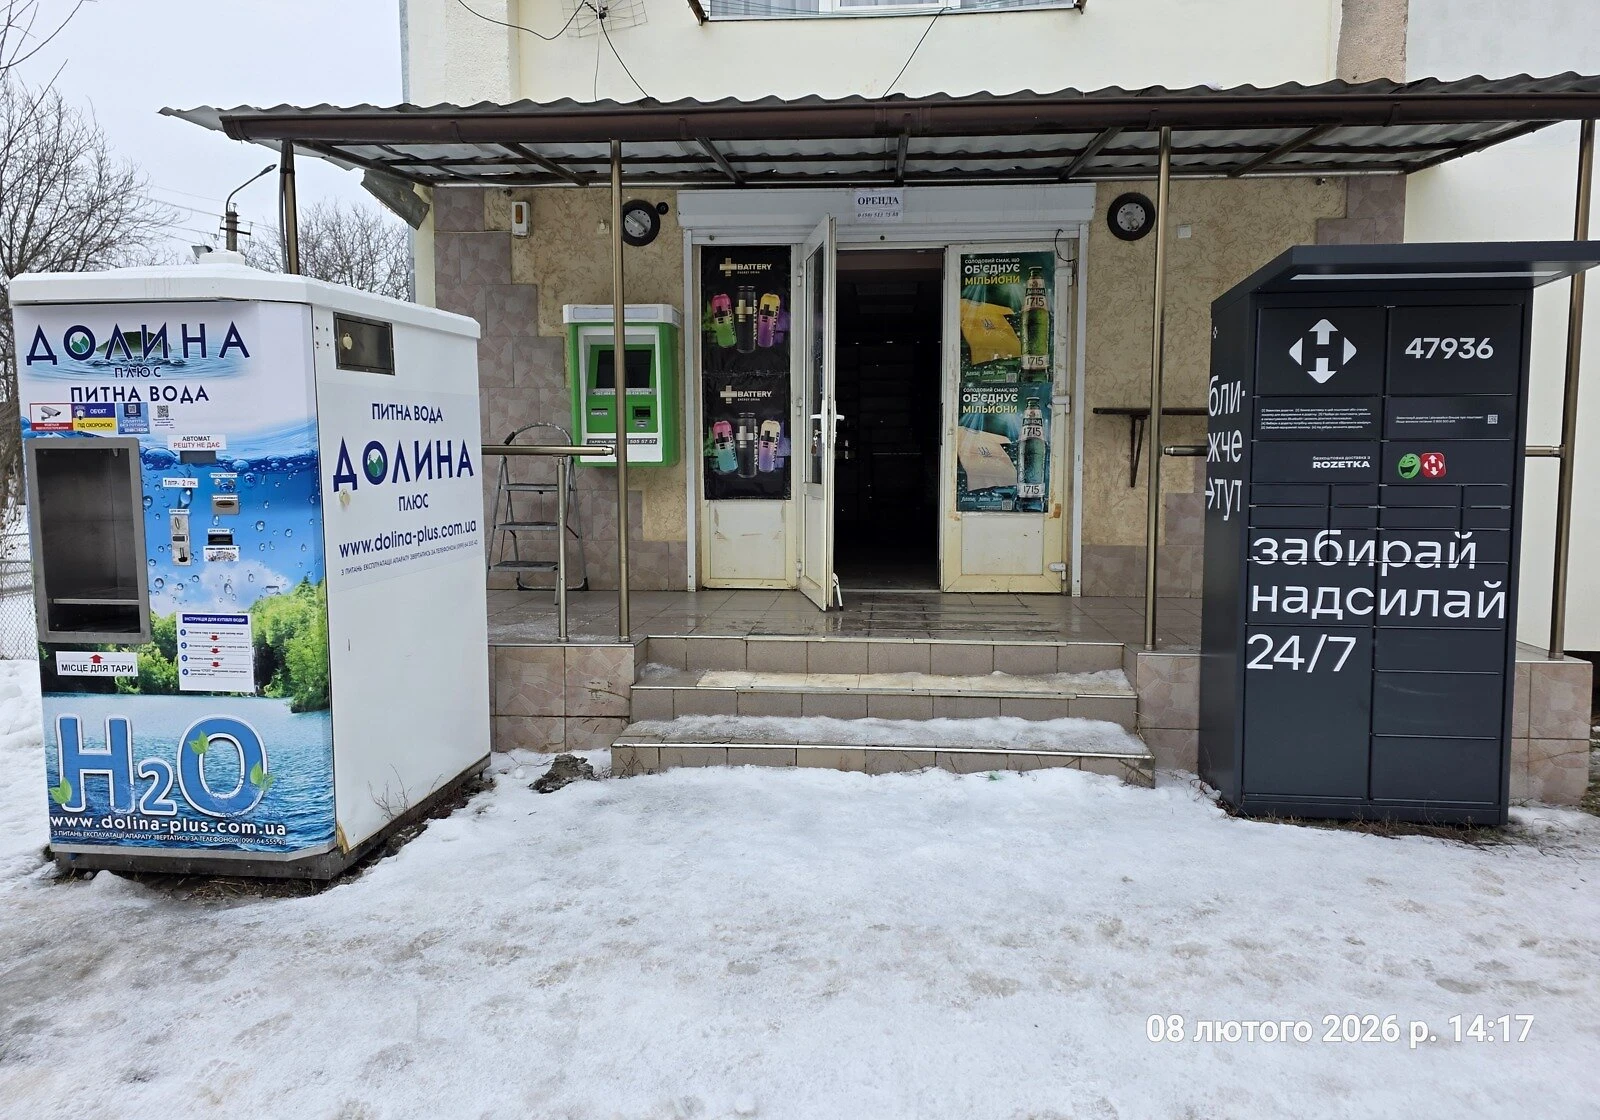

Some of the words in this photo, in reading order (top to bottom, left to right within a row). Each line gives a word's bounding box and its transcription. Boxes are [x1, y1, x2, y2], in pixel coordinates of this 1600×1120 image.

[857, 196, 899, 206] ОРЕНДА
[737, 263, 772, 271] BATTERY
[964, 263, 1021, 275] ОБ'ЄДНУЄ
[964, 274, 1020, 286] МІЛЬЙОНИ
[1025, 296, 1046, 307] 1715
[26, 320, 251, 366] ДОЛИНА
[1404, 336, 1494, 360] 47936
[1027, 356, 1044, 366] 1715
[114, 366, 162, 379] ПЛЮС
[70, 386, 142, 403] ПИТНА
[149, 385, 210, 404] ВОДА
[737, 390, 773, 398] BATTERY
[962, 393, 1018, 404] ОБ'ЄДНУЄ
[371, 403, 412, 421] ПИТНА
[413, 405, 444, 424] ВОДА
[962, 404, 1018, 414] МІЛЬЙОНИ
[1023, 426, 1042, 437] 1715
[206, 441, 221, 449] ДАЄ
[1206, 429, 1243, 463] жче
[332, 435, 475, 493] ДОЛИНА
[1312, 460, 1371, 469] ROZETKA
[1023, 485, 1040, 495] 1715
[398, 493, 429, 512] ПЛЮС
[1214, 478, 1243, 521] тут
[339, 519, 477, 558] www.dolina-plus.com.ua
[1252, 529, 1477, 577] забирай
[1251, 580, 1506, 620] надсилай
[1246, 633, 1357, 674] 24/7
[61, 664, 88, 672] МІСЦЕ
[90, 664, 108, 673] ДЛЯ
[110, 664, 134, 673] ТАРИ
[50, 814, 286, 836] www.dolina-plus.com.ua
